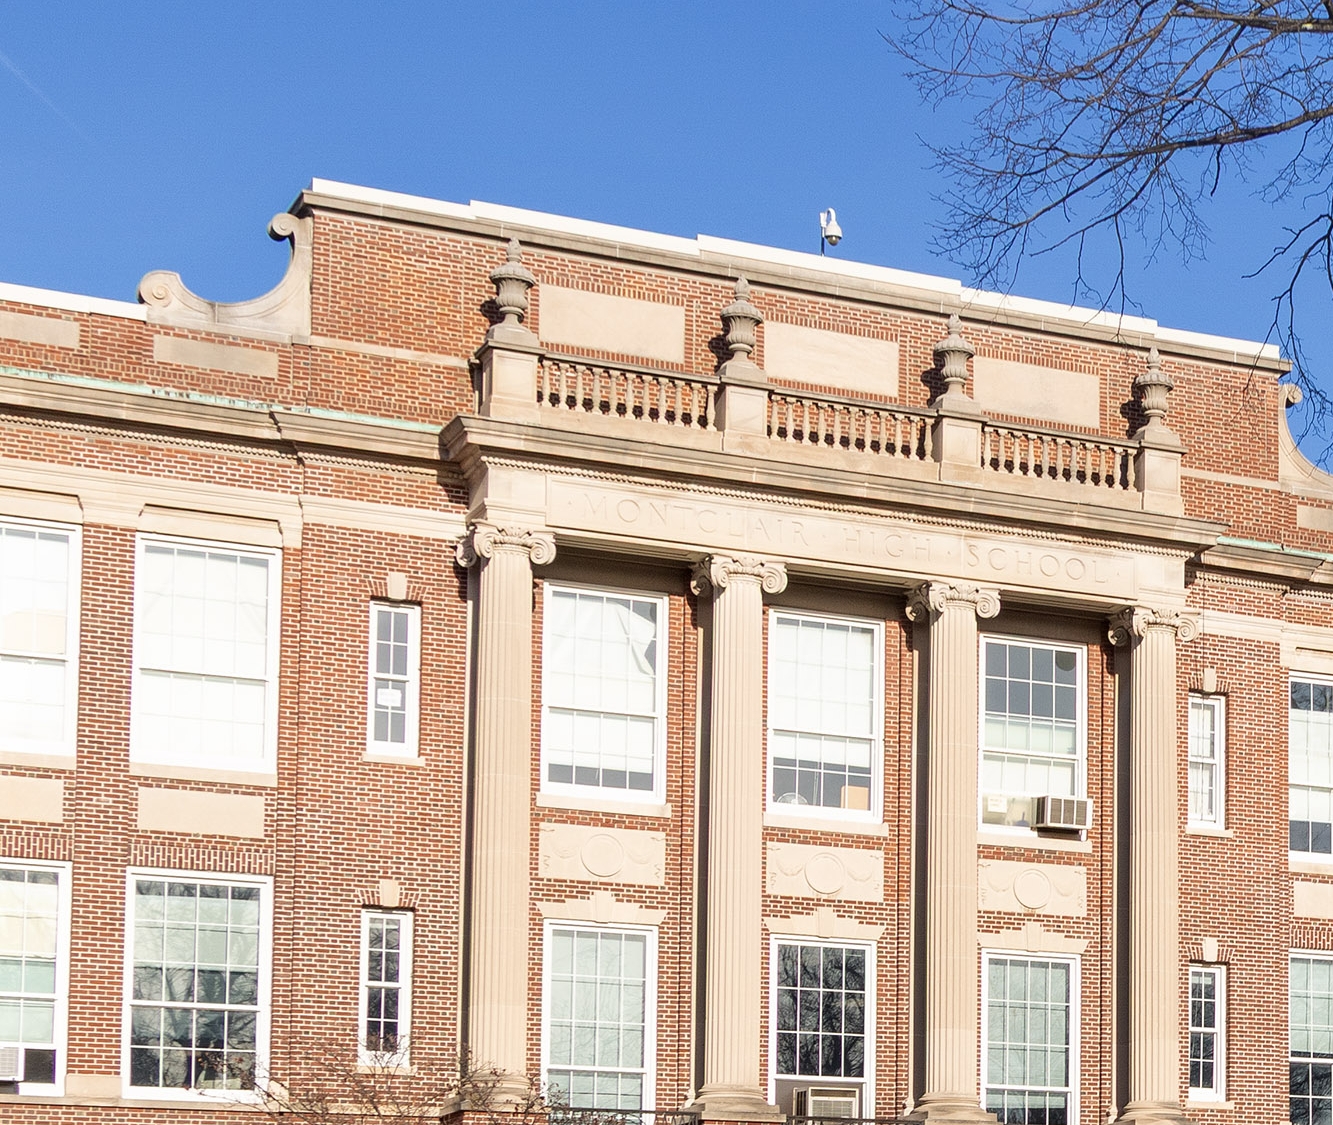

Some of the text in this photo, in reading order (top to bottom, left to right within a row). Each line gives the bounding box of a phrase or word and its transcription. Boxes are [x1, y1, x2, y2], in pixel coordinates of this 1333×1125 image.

[583, 492, 1109, 584] MONTCLAIR HIGH SCHOOL
